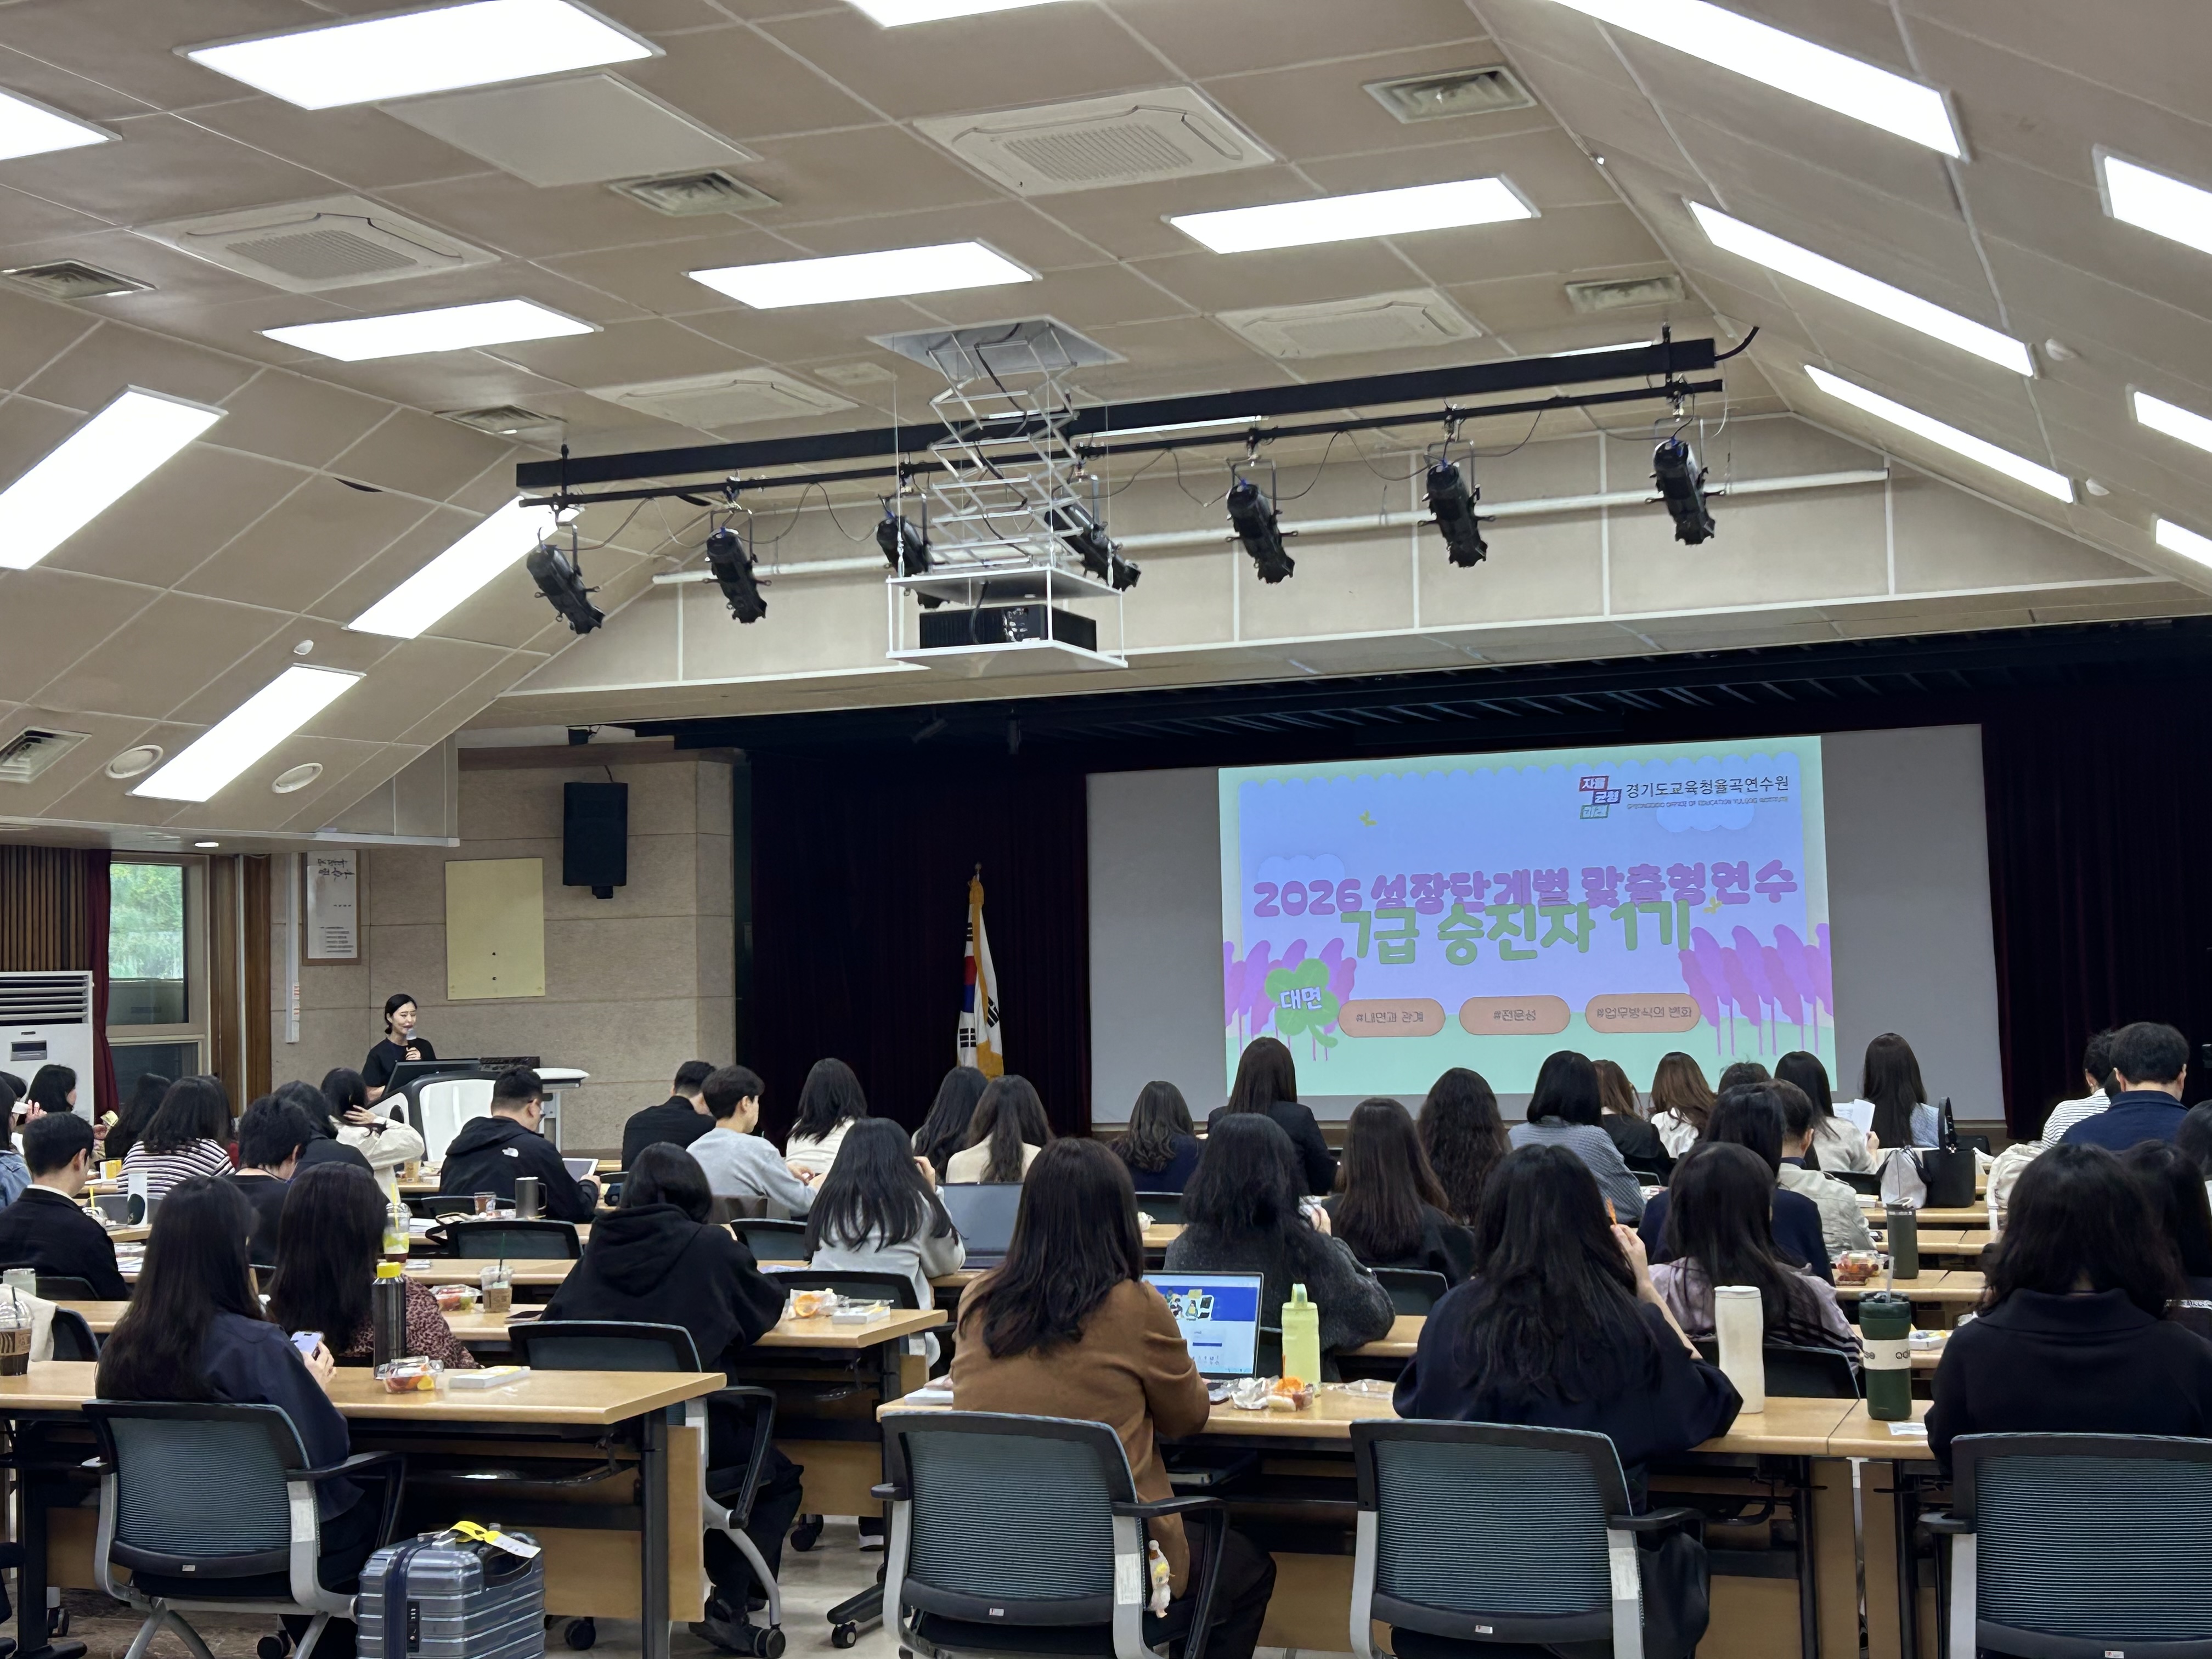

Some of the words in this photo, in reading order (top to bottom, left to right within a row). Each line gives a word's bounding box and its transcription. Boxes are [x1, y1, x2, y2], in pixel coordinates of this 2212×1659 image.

[1626, 775, 1789, 798] 경기도교육청율곡연수원
[1253, 878, 1363, 917] 2026
[1370, 867, 1570, 915] 성장단계별
[1340, 906, 1420, 964] 7급
[1437, 901, 1596, 966] 승진자
[1609, 898, 1690, 951] 1기
[1279, 986, 1322, 1010] 대면
